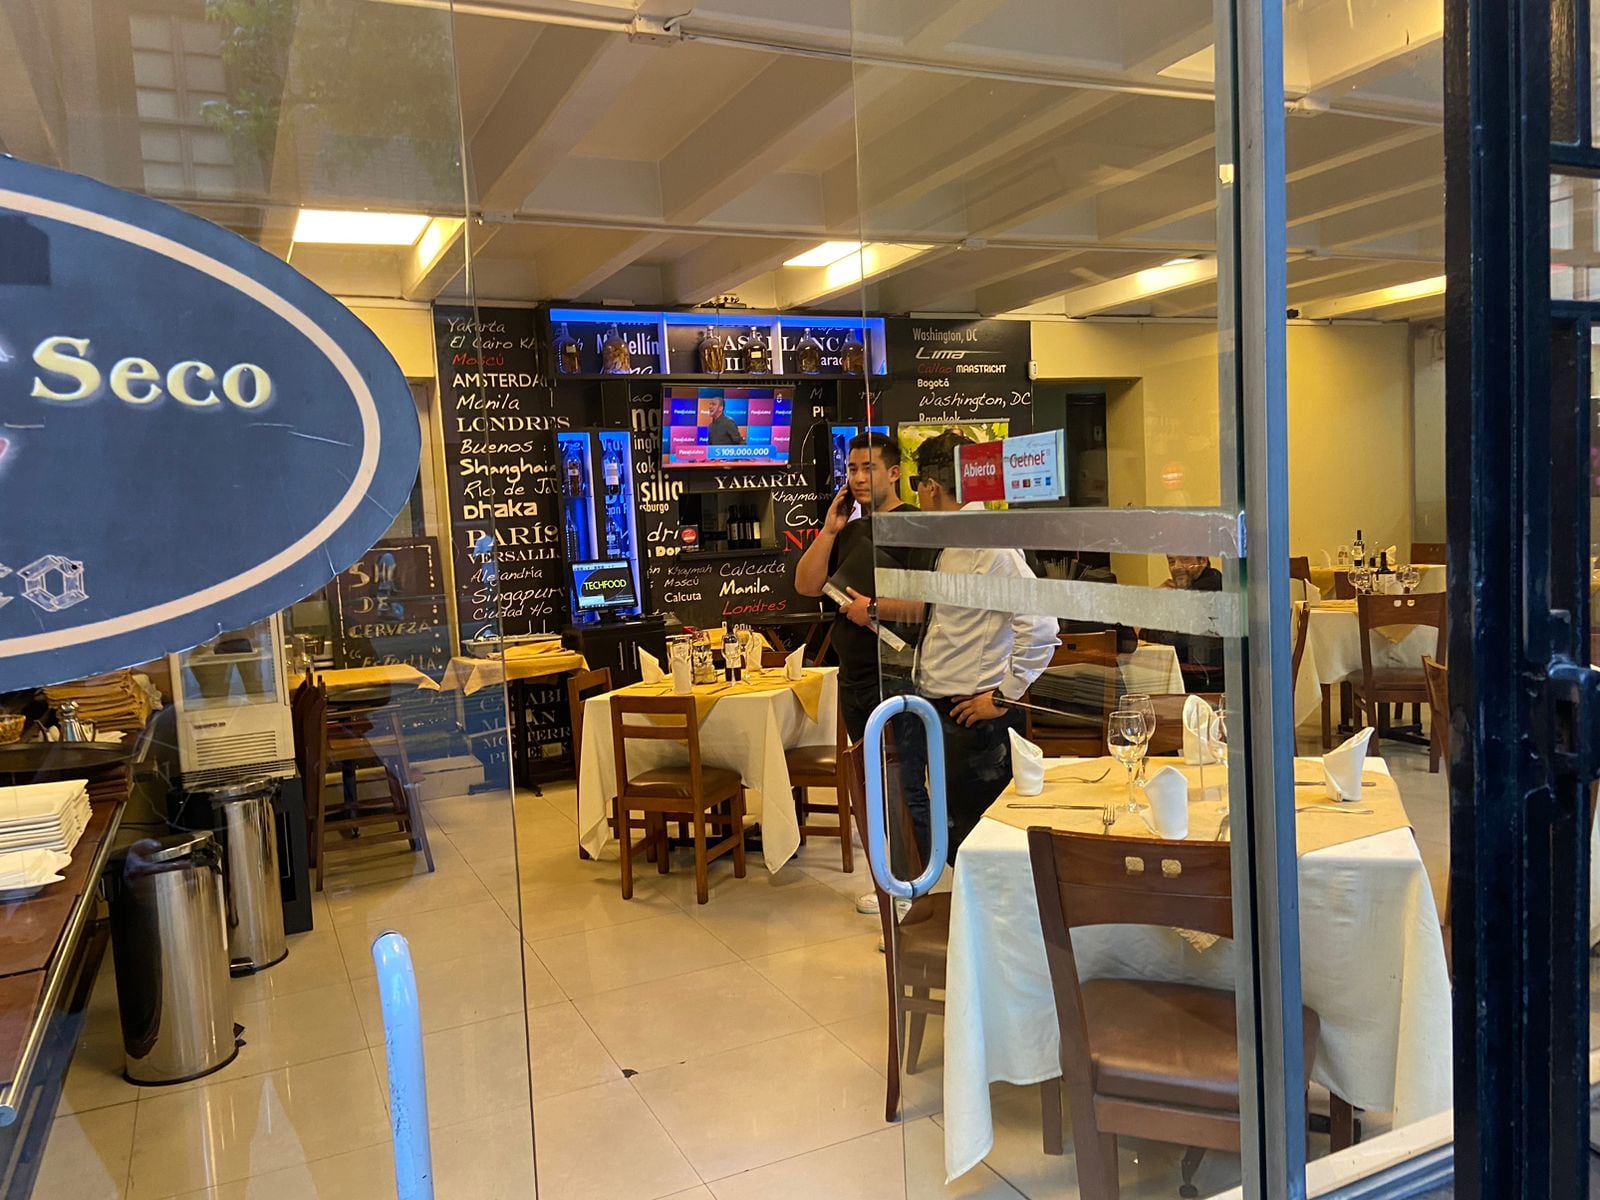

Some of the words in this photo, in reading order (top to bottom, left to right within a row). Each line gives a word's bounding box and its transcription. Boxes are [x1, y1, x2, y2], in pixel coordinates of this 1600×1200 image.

[447, 317, 505, 334] Yakarta
[449, 335, 466, 349] El
[472, 337, 513, 350] Cairo
[912, 327, 964, 344] Washington,
[965, 328, 978, 342] DC
[30, 335, 273, 410] Seco
[955, 364, 1007, 374] MAASTRICHT
[917, 377, 950, 390] Bogotá
[455, 393, 521, 410] Manila
[919, 391, 1007, 413] Washington,
[1009, 390, 1032, 406] DC
[456, 415, 571, 433] LONDRES
[459, 438, 534, 455] Buenos
[1009, 450, 1046, 469] Getnet
[459, 457, 549, 484] Shanghai
[963, 463, 997, 478] Abierto
[503, 481, 525, 496] de
[713, 472, 809, 490] YAKARTA
[719, 560, 786, 577] Calcuta
[583, 579, 627, 591] TECHFOOD
[719, 577, 771, 597] Manila
[664, 591, 702, 603] Calcuta
[722, 600, 787, 616] Londres
